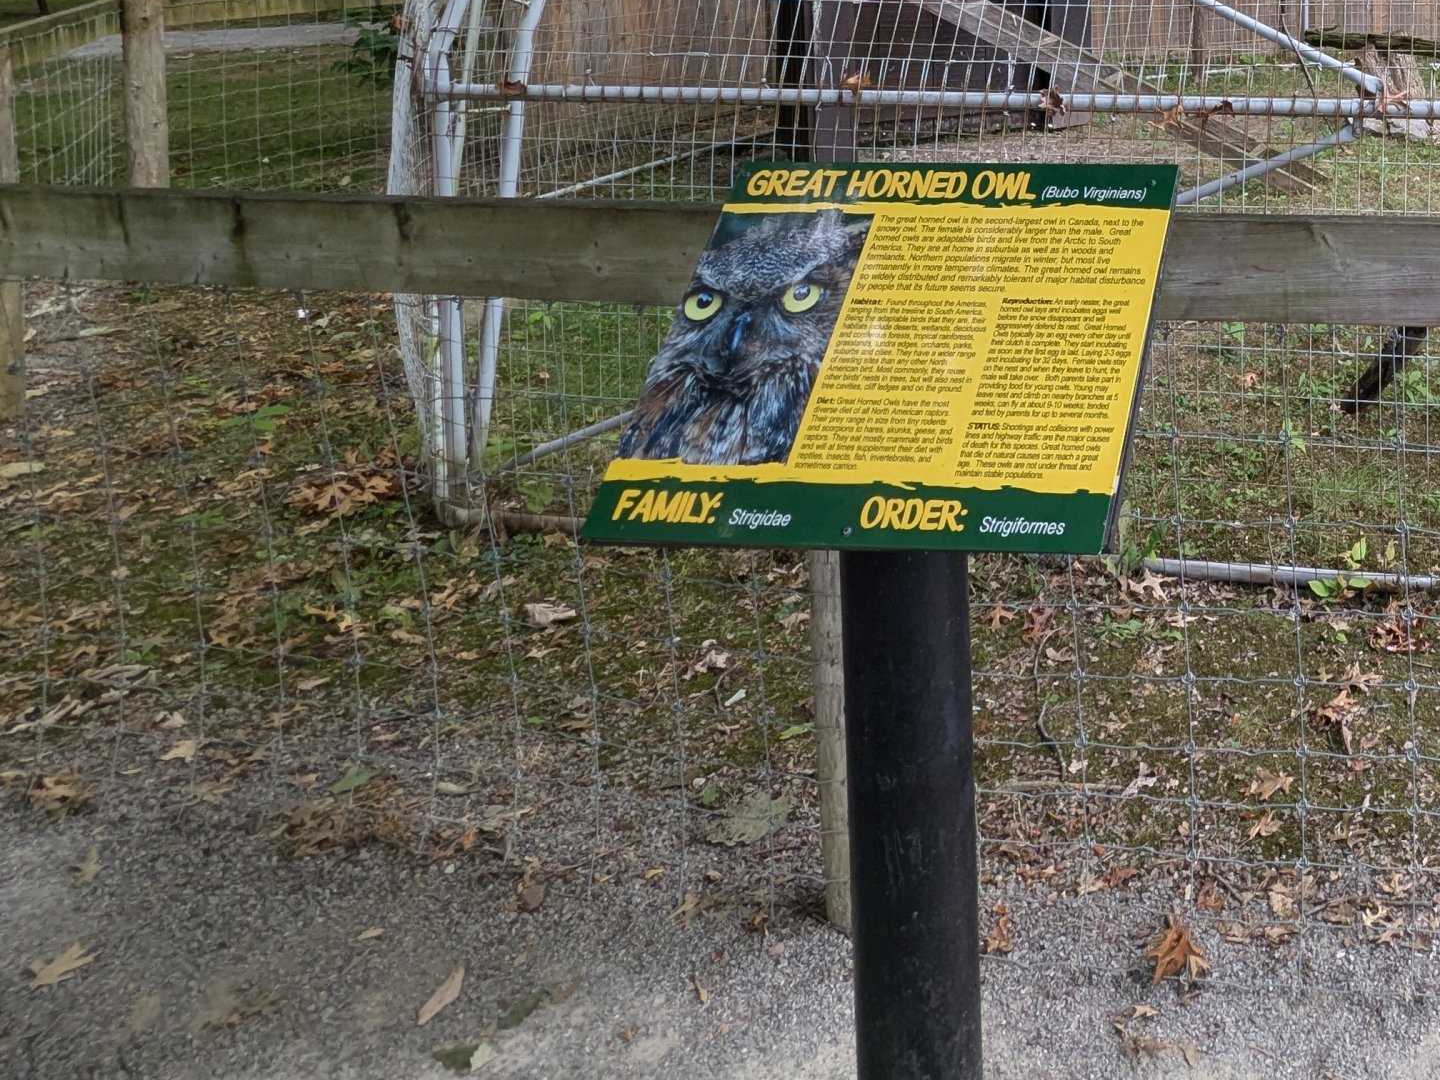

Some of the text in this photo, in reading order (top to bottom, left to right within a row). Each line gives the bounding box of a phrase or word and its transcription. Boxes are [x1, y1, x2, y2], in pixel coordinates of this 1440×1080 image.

[747, 169, 1147, 202] GREAT HORNED OWL (Bubo Virginians)
[896, 216, 917, 224] great
[971, 216, 983, 224] the
[1043, 217, 1057, 225] owl
[1058, 217, 1066, 225] in
[1103, 218, 1120, 226] next
[1122, 218, 1129, 226] to
[1131, 218, 1144, 226] the
[876, 226, 901, 234] snowy
[974, 226, 1023, 236] considerably
[1025, 227, 1048, 236] larger
[1068, 227, 1081, 235] the
[902, 234, 919, 242] owls
[936, 235, 974, 243] adaptable
[976, 235, 995, 243] birds
[1014, 235, 1028, 243] live
[1030, 236, 1048, 244] from
[1050, 236, 1062, 244] the
[1064, 236, 1086, 244] Arctic
[1098, 237, 1121, 245] South
[907, 244, 926, 253] They
[942, 244, 950, 252] at
[952, 244, 974, 252] home
[985, 245, 1018, 253] suburbia
[1061, 246, 1069, 254] in
[1071, 246, 1096, 254] woods
[909, 253, 943, 261] Northern
[944, 254, 989, 263] populations
[992, 255, 1021, 264] migrate
[1023, 255, 1031, 263] in
[1060, 256, 1074, 264] but
[1075, 256, 1095, 264] most
[1096, 256, 1110, 264] live
[862, 263, 911, 272] permanently
[1024, 265, 1039, 273] The
[1040, 266, 1062, 274] great
[1093, 266, 1108, 274] owl
[871, 273, 896, 282] widely
[898, 273, 939, 281] distributed
[958, 274, 1001, 283] remarkably
[1035, 275, 1044, 283] of
[1045, 276, 1068, 285] major
[1070, 276, 1097, 284] habitat
[1099, 276, 1145, 284] disturbance
[856, 282, 866, 291] by
[867, 283, 894, 291] people
[925, 283, 947, 291] future
[612, 489, 791, 529] FAMILY: Strigidae
[860, 495, 1066, 537] ORDER: Strigiformes
